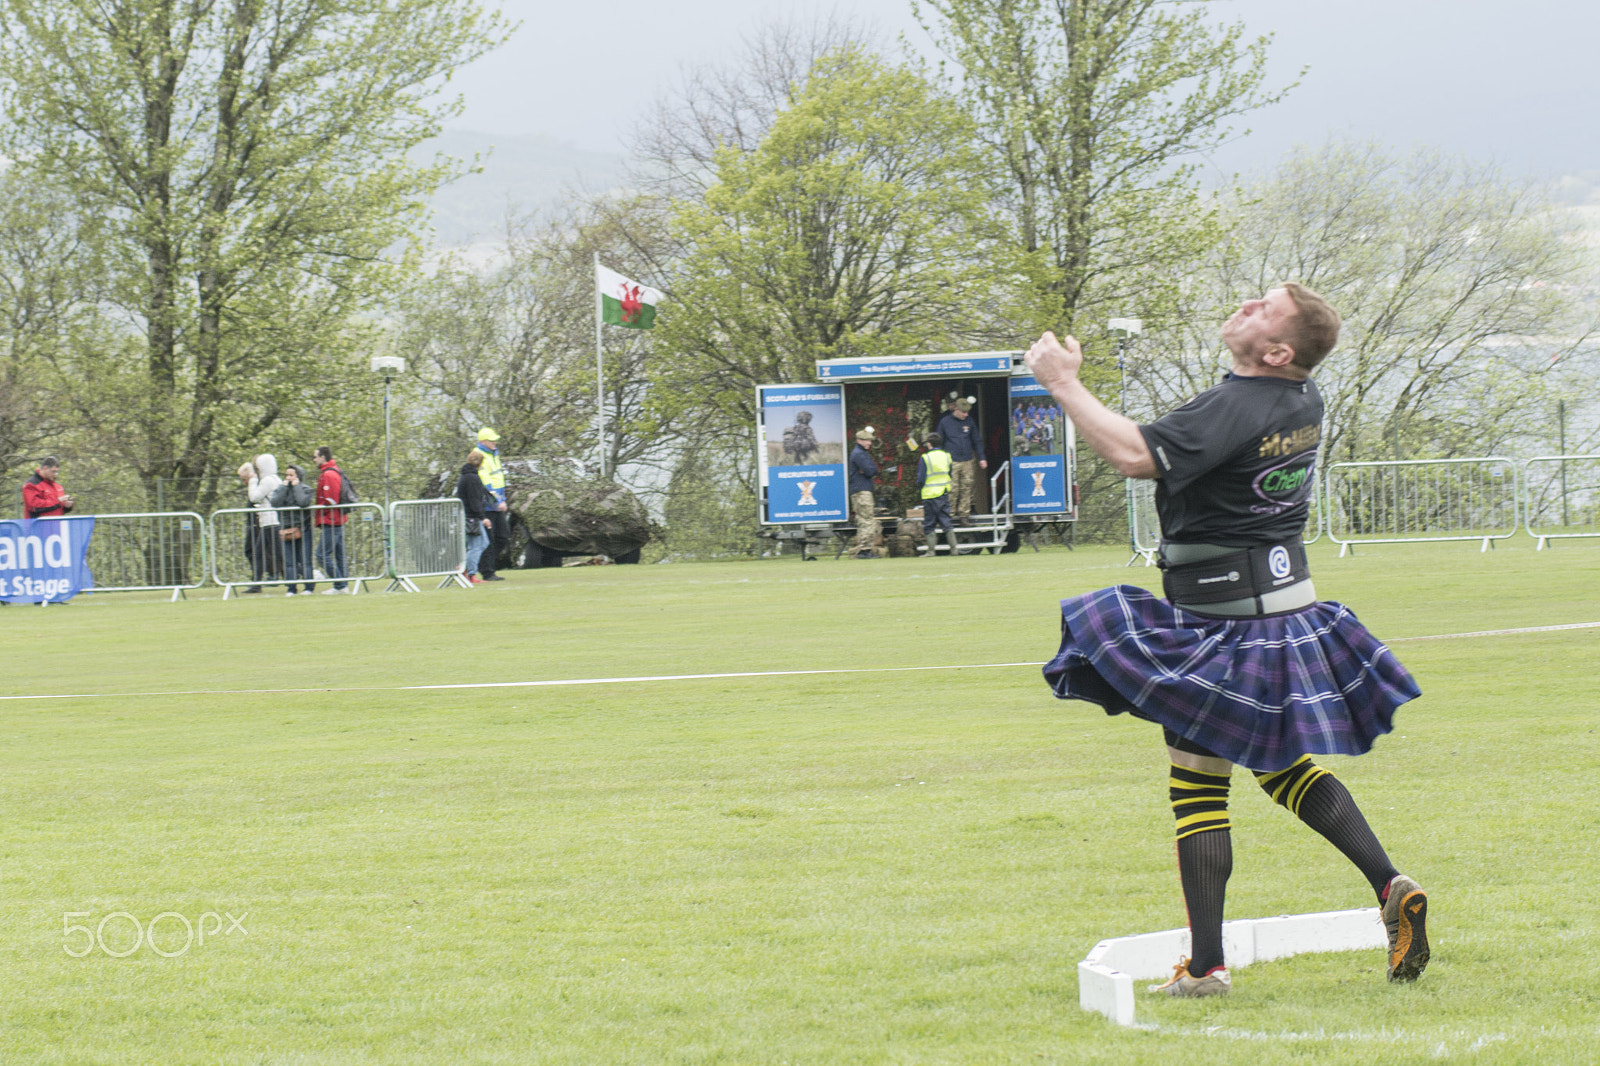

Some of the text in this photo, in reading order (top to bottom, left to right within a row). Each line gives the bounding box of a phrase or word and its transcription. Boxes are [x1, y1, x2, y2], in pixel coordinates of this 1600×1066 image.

[765, 393, 840, 403] SCOTLAND'S FUSILIERS
[12, 575, 70, 600] Stage
